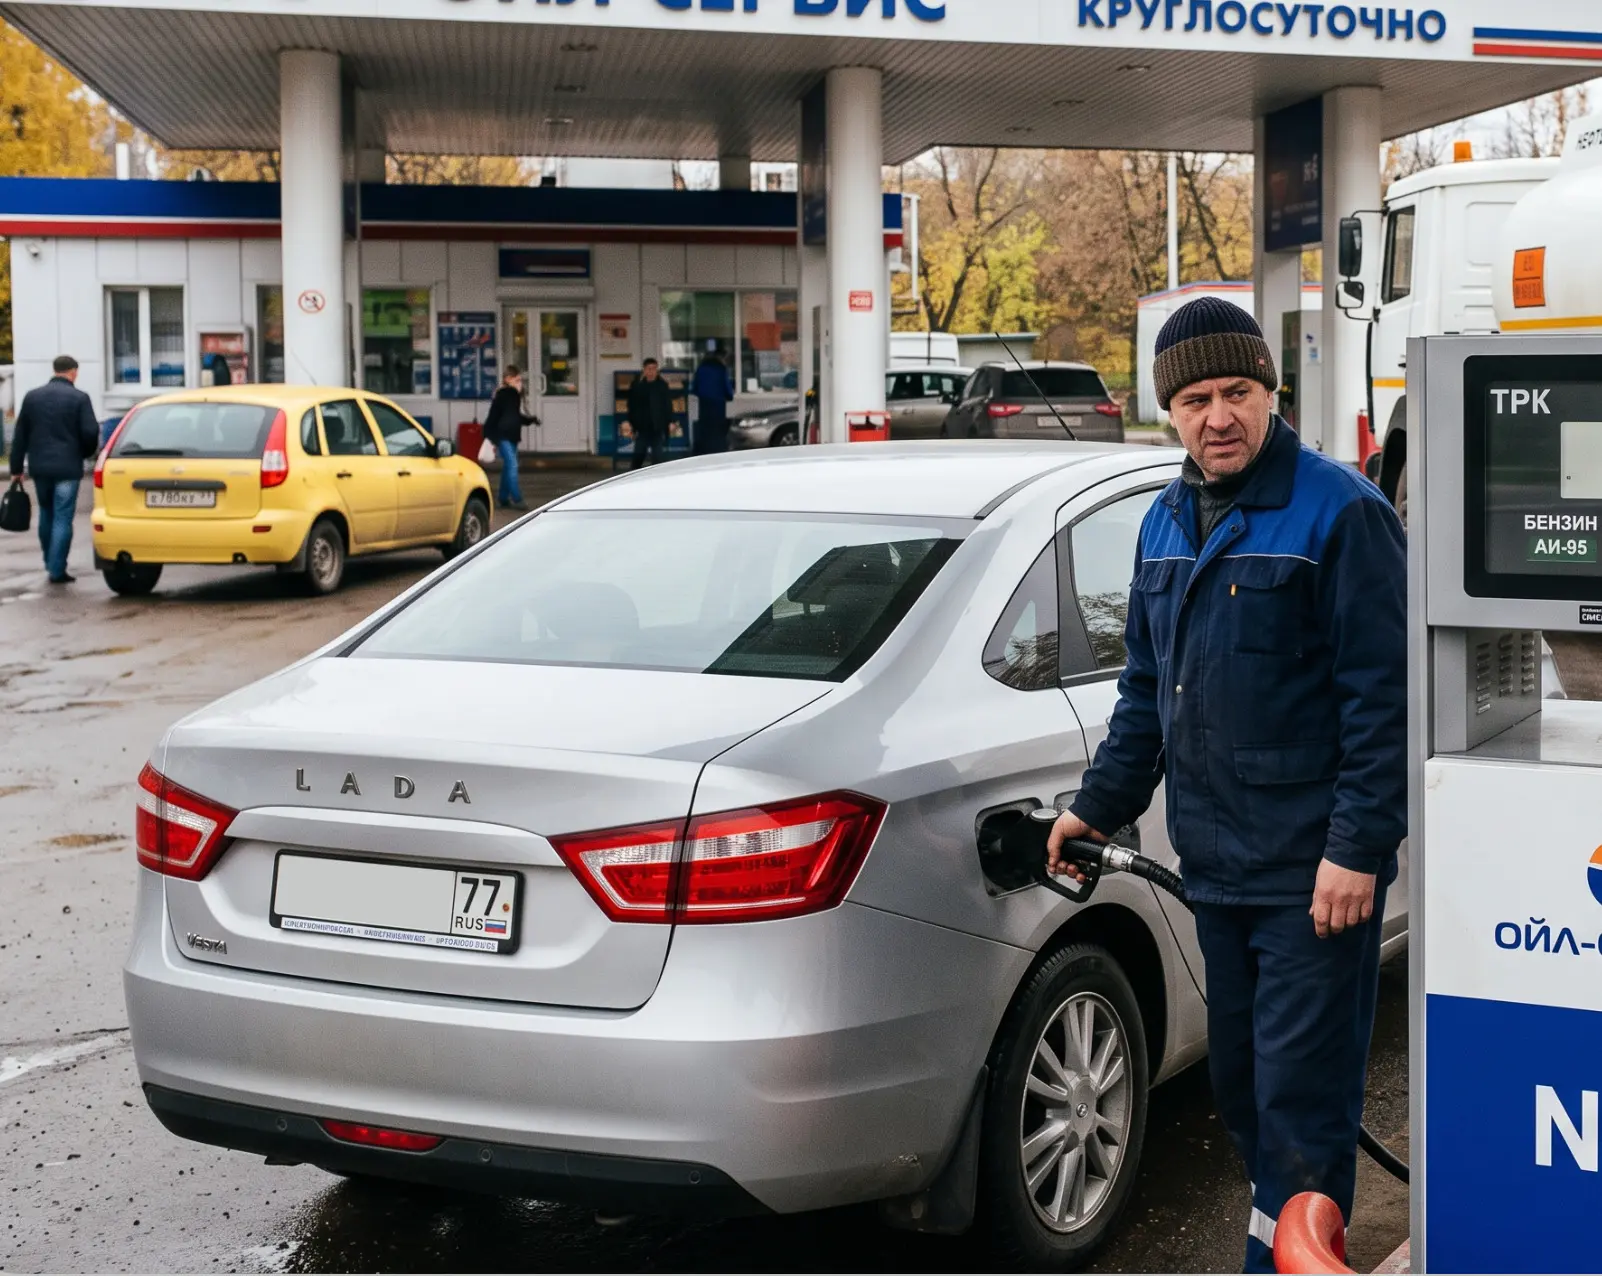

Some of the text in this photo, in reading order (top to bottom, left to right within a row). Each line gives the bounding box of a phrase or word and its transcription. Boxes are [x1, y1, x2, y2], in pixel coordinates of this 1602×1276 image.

[1079, 0, 1447, 41] КРУГЛОСУТОЧНО
[1490, 388, 1551, 414] ТРК
[1524, 514, 1598, 531] БЕНЗИН
[1534, 539, 1588, 555] АИ-95
[296, 767, 471, 804] LADA
[461, 877, 501, 916] 77
[455, 916, 484, 931] RUS
[1494, 916, 1602, 956] ОЙЛ-
